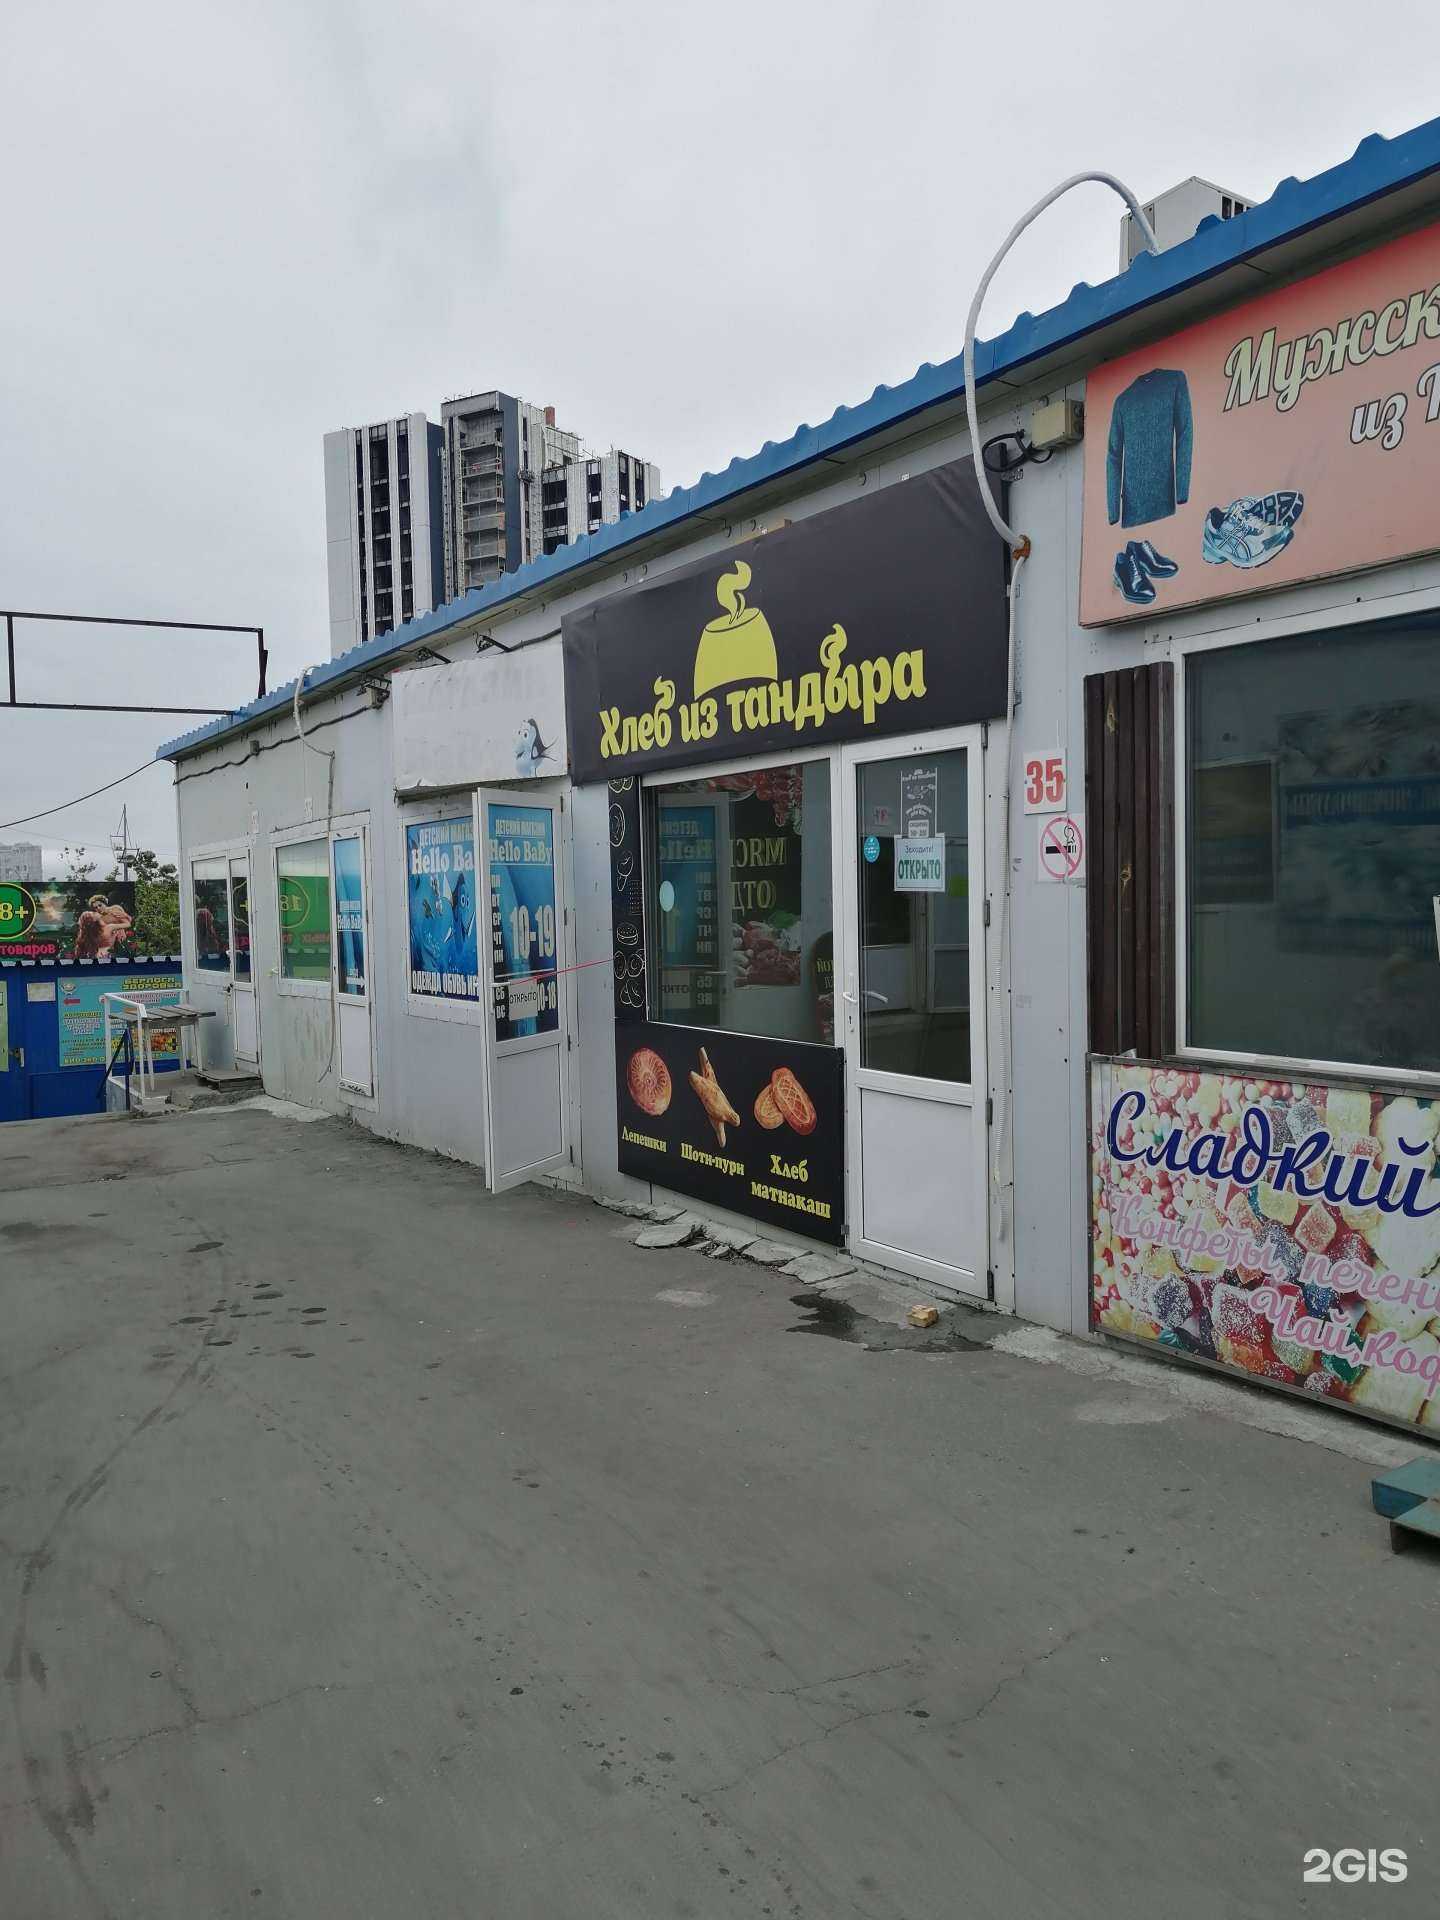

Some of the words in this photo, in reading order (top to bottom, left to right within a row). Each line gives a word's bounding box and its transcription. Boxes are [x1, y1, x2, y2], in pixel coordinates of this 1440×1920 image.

[1350, 393, 1408, 450] из
[600, 676, 675, 758] Хлеб
[680, 697, 719, 743] из
[726, 624, 927, 731] тандыра
[1026, 758, 1064, 805] 35
[411, 846, 450, 874] Hello
[489, 839, 520, 863] Hello
[898, 859, 940, 880] ОТКРЫТО
[492, 912, 502, 926] СР
[510, 905, 555, 960] 10-19
[493, 931, 503, 945] ЧТ
[412, 970, 442, 994] ОДЕЖДА
[442, 972, 467, 996] ОБУВЬ
[621, 1125, 667, 1153] Лепешки
[681, 1142, 745, 1176] Шоти-пури
[1107, 1090, 1440, 1217] Сладкий
[770, 1154, 809, 1182] Хлеб
[751, 1181, 831, 1219] матнакаш
